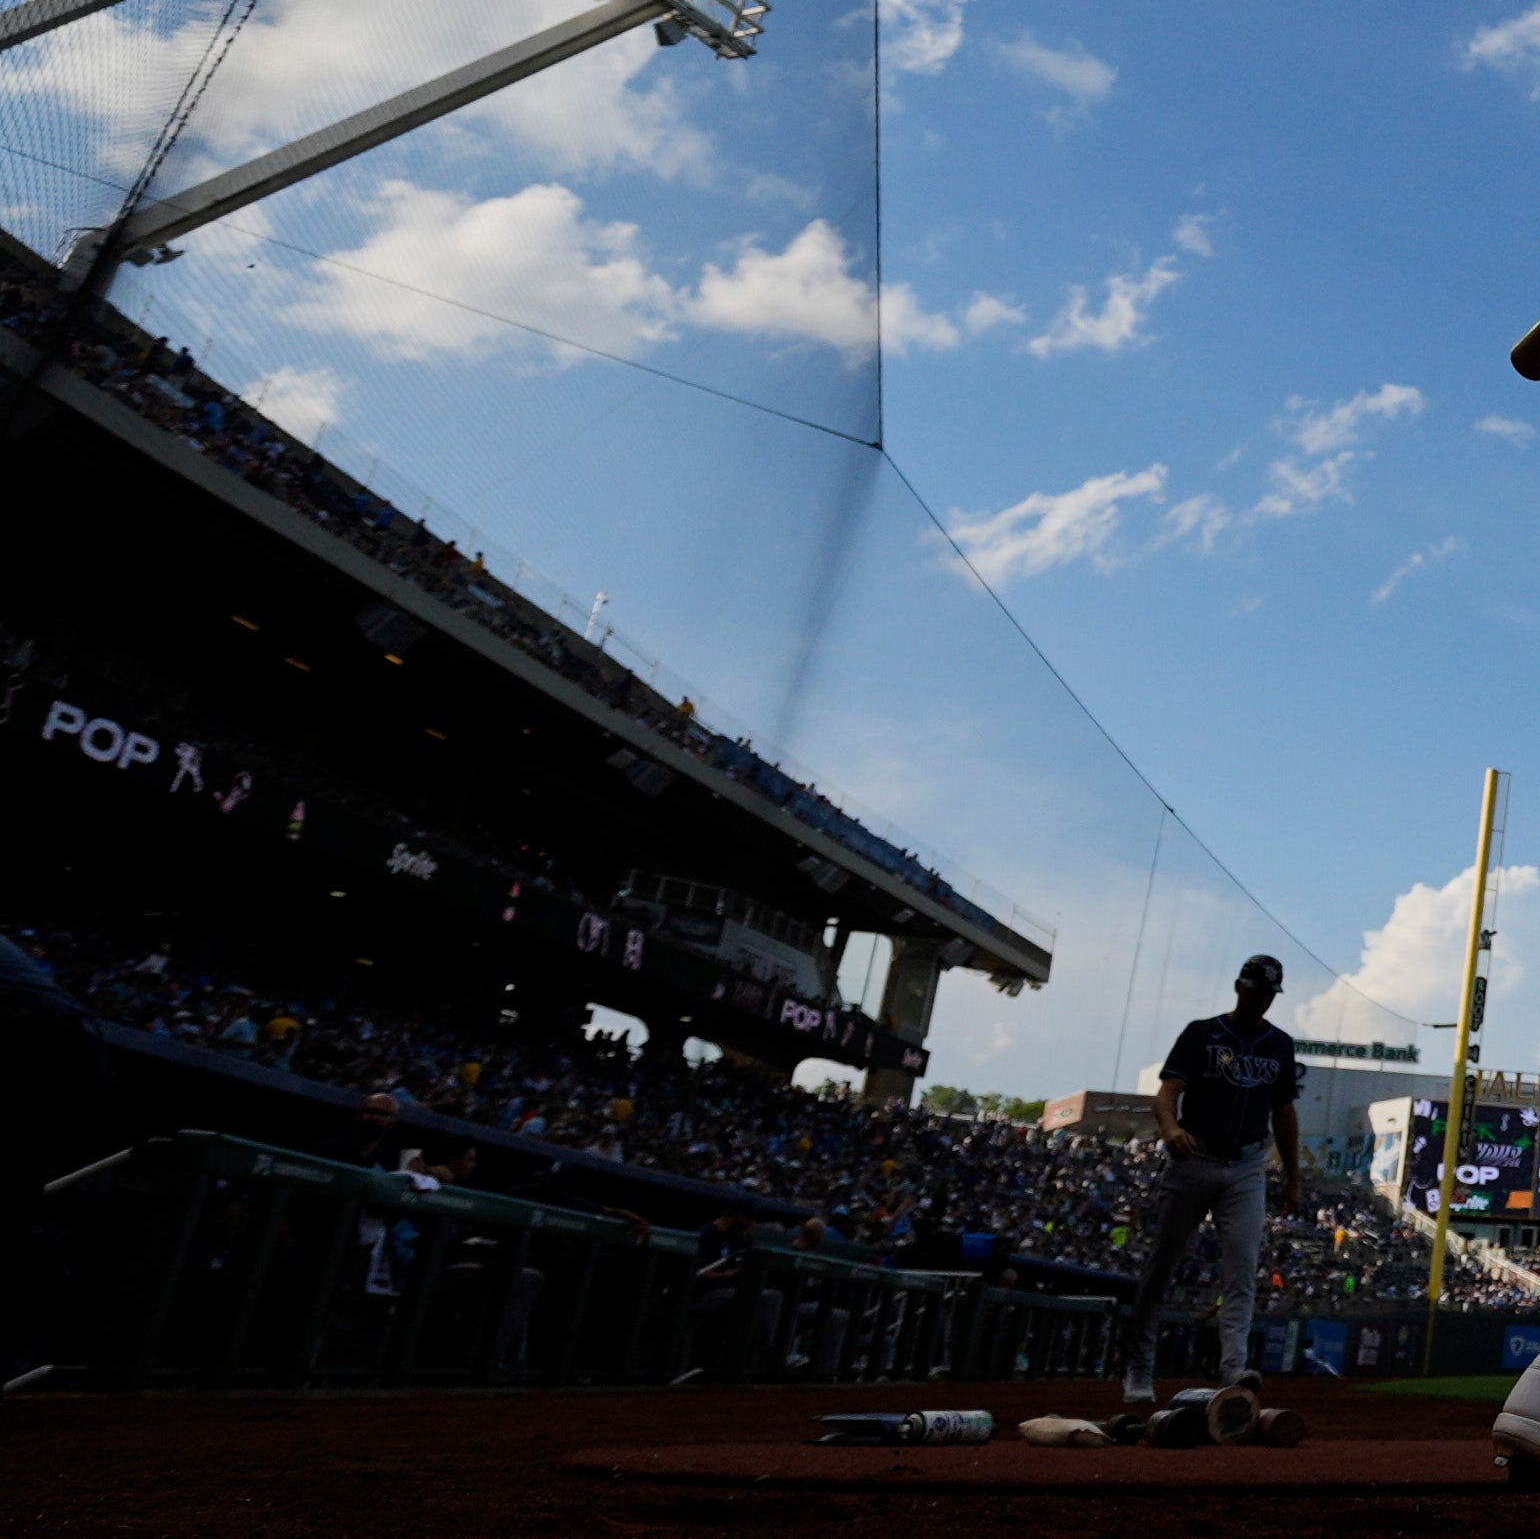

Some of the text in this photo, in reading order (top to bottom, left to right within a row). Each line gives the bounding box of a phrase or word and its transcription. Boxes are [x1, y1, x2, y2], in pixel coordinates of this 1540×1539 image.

[41, 700, 161, 770] POP
[1293, 1038, 1419, 1062] mmerce Bank
